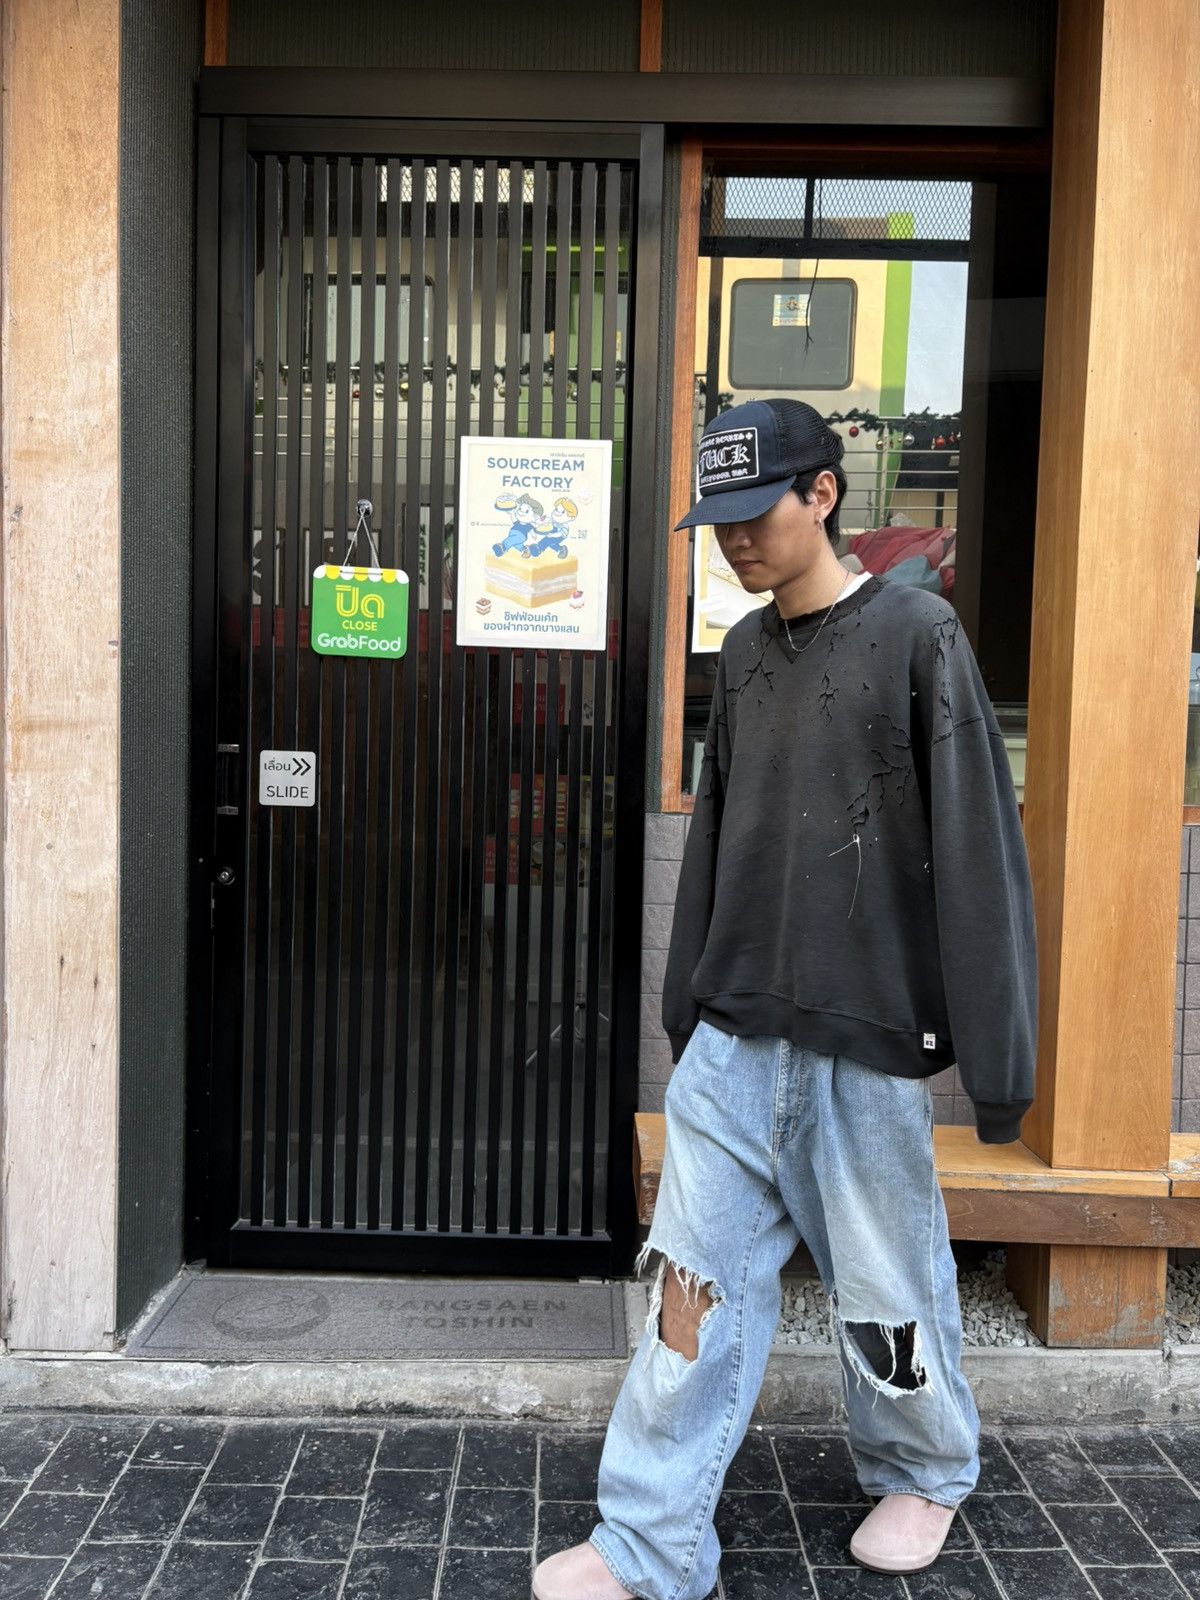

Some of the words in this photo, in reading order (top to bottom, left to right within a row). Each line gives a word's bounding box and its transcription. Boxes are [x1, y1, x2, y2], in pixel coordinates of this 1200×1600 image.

[487, 457, 585, 472] SOURCREAM
[699, 443, 751, 476] FUCK
[502, 475, 574, 490] FACTORY
[335, 584, 385, 619] ปิด
[342, 619, 378, 632] CLOSE
[483, 621, 580, 634] ของฝากจากบางแสน
[317, 632, 401, 652] GrabFood
[264, 757, 291, 771] เลื่อน
[266, 785, 309, 799] SLIDE
